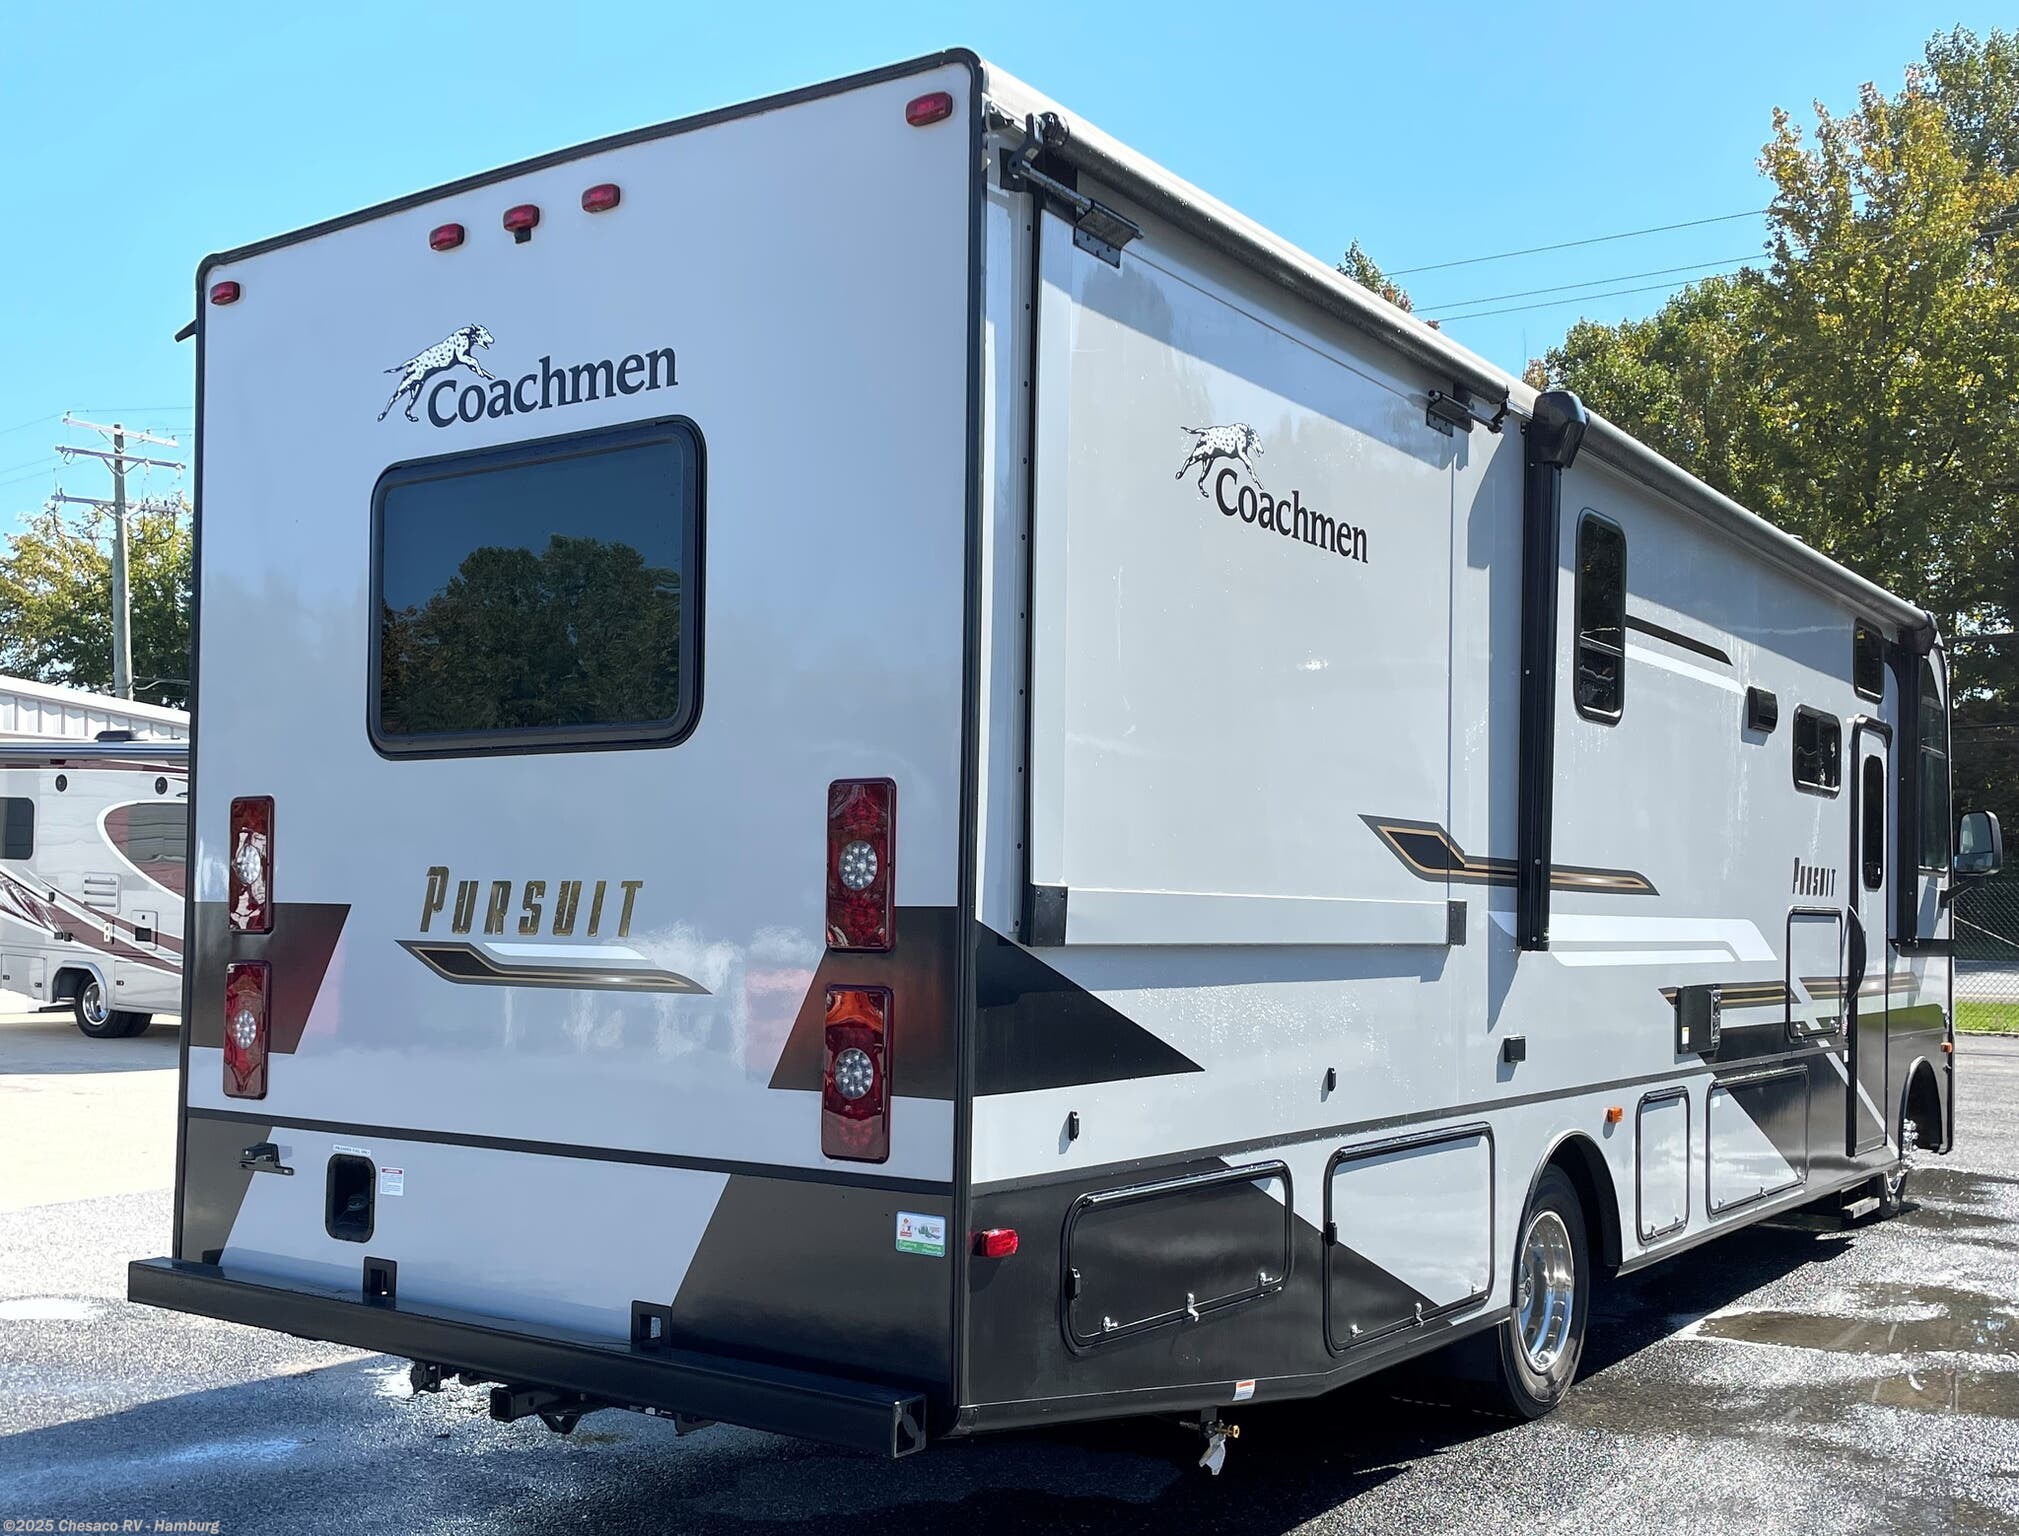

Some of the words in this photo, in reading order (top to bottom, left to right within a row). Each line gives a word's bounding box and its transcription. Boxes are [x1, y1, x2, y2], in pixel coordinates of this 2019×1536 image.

[427, 347, 679, 428] Coachmen
[1215, 467, 1369, 564] Coachmen
[419, 865, 644, 938] PURSUIT
[1792, 857, 1836, 897] PURSUIT
